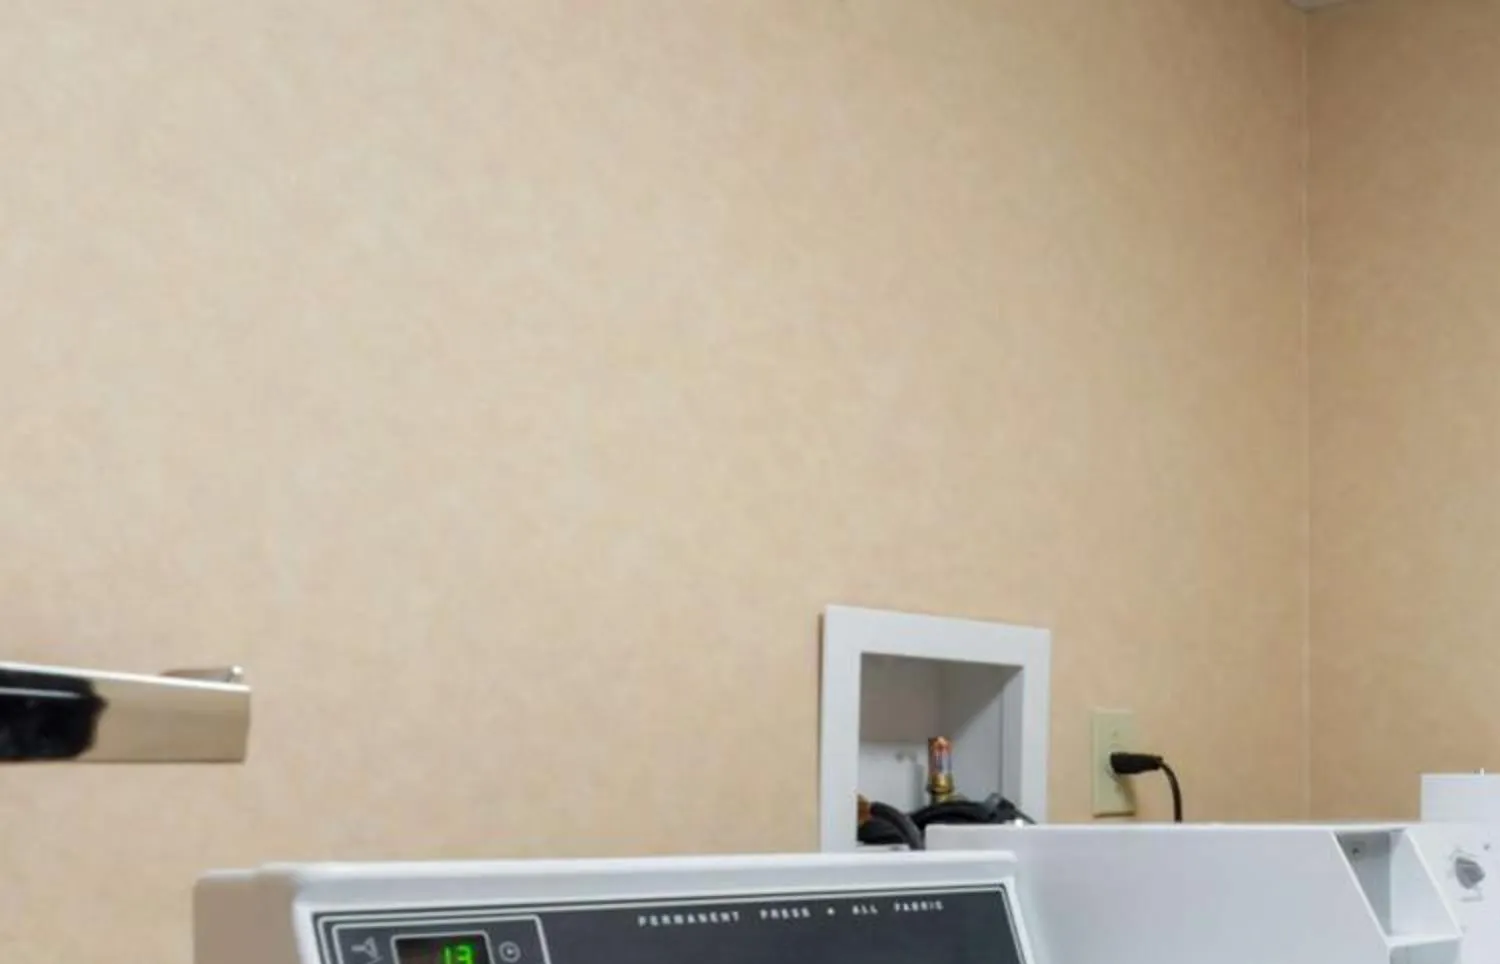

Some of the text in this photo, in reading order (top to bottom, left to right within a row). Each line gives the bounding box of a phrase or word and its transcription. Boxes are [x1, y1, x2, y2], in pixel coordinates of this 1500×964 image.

[637, 900, 945, 927] PERMANENT PRESS ALL FABRIC
